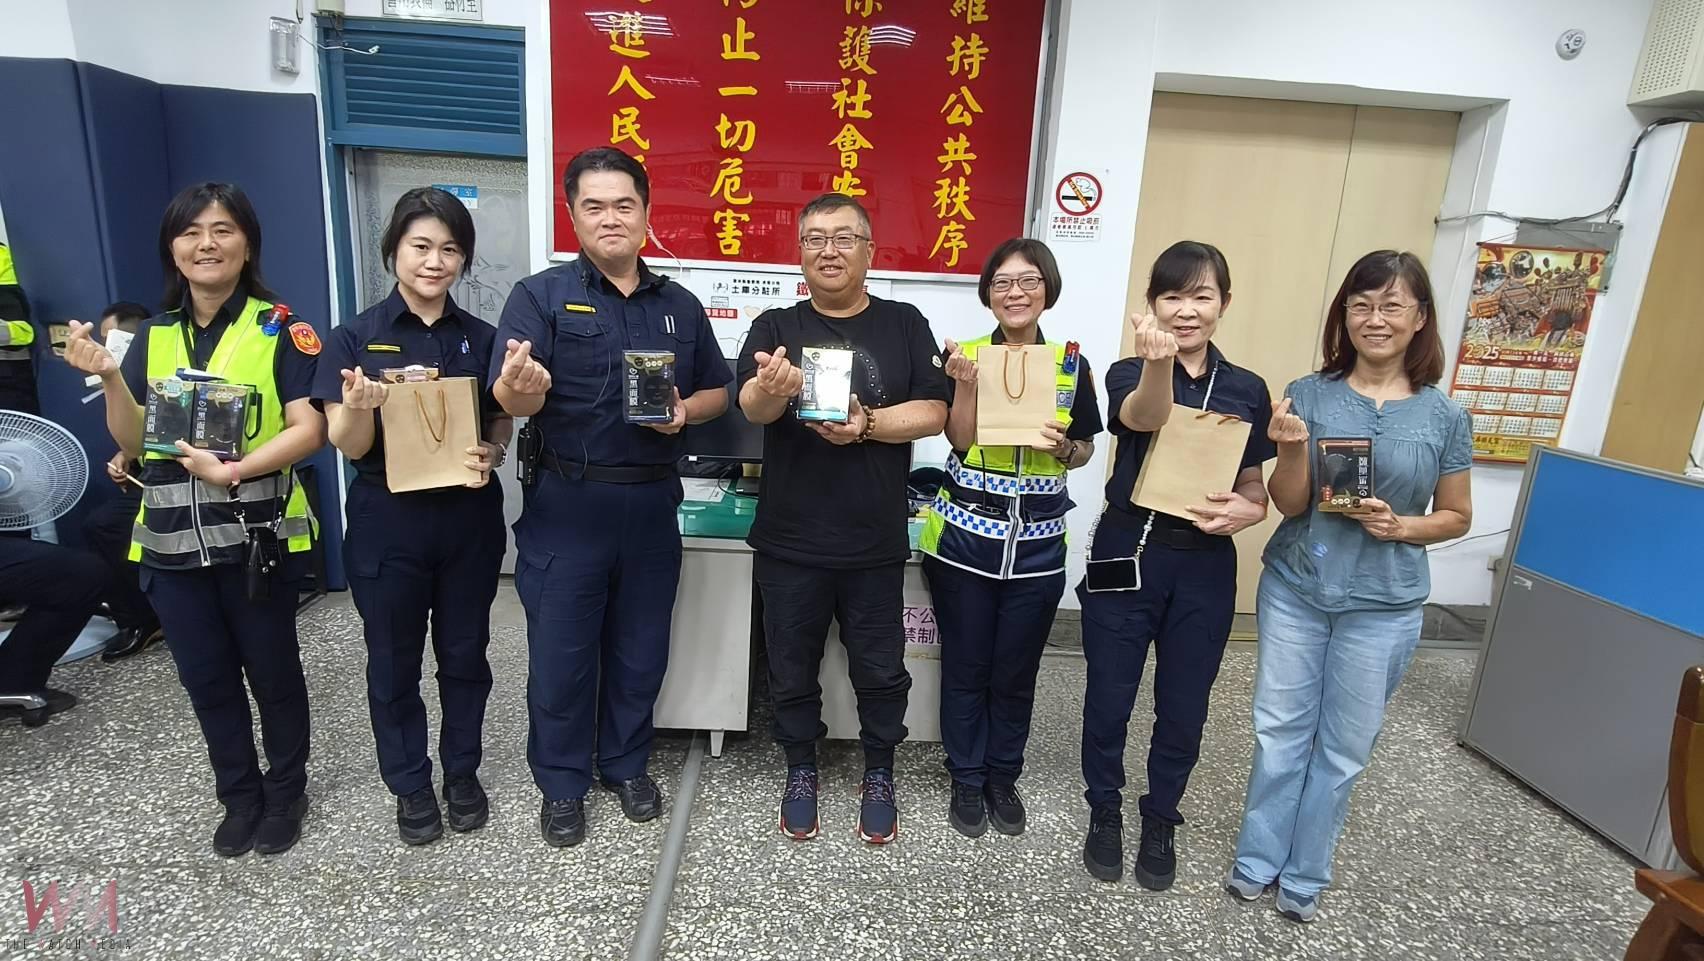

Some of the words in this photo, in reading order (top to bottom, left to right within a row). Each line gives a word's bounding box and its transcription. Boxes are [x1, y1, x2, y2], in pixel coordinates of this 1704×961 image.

[709, 0, 762, 257] 止一切危害
[904, 627, 942, 645] 禁制
